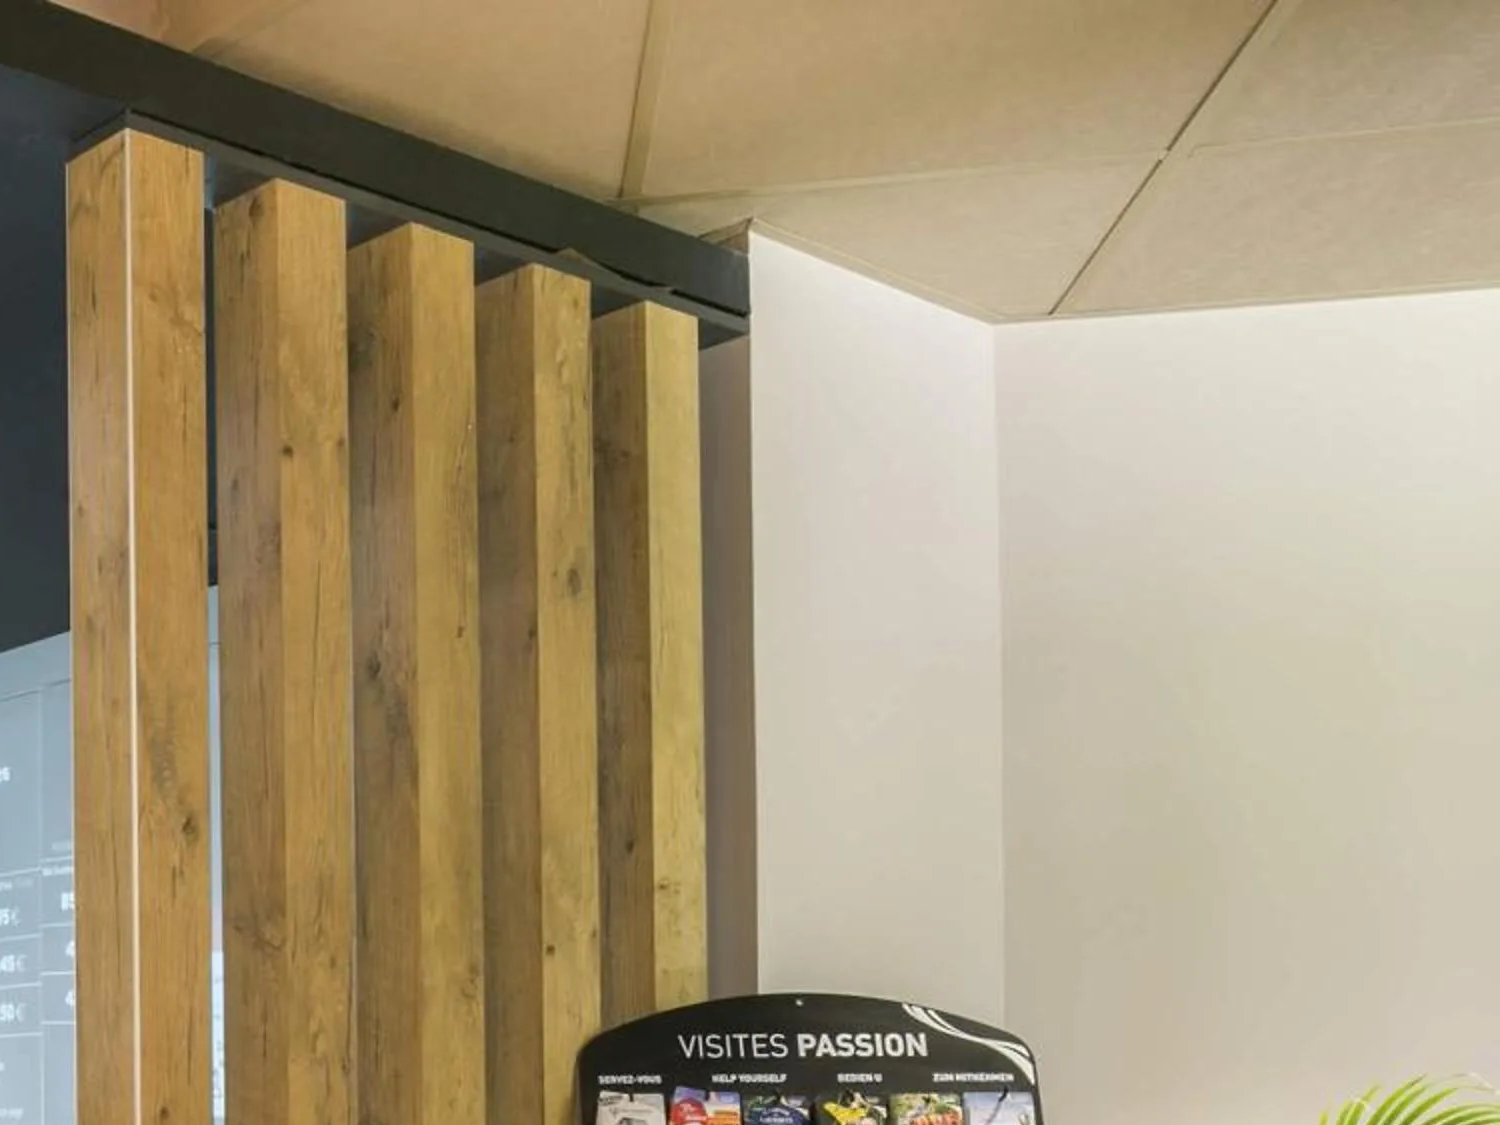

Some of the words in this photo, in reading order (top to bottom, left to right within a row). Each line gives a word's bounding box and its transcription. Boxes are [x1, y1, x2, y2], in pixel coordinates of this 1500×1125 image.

[678, 1032, 788, 1059] VISITES
[797, 1032, 929, 1058] PASSION
[711, 1073, 737, 1083] HELP
[738, 1073, 787, 1083] YOURSELF
